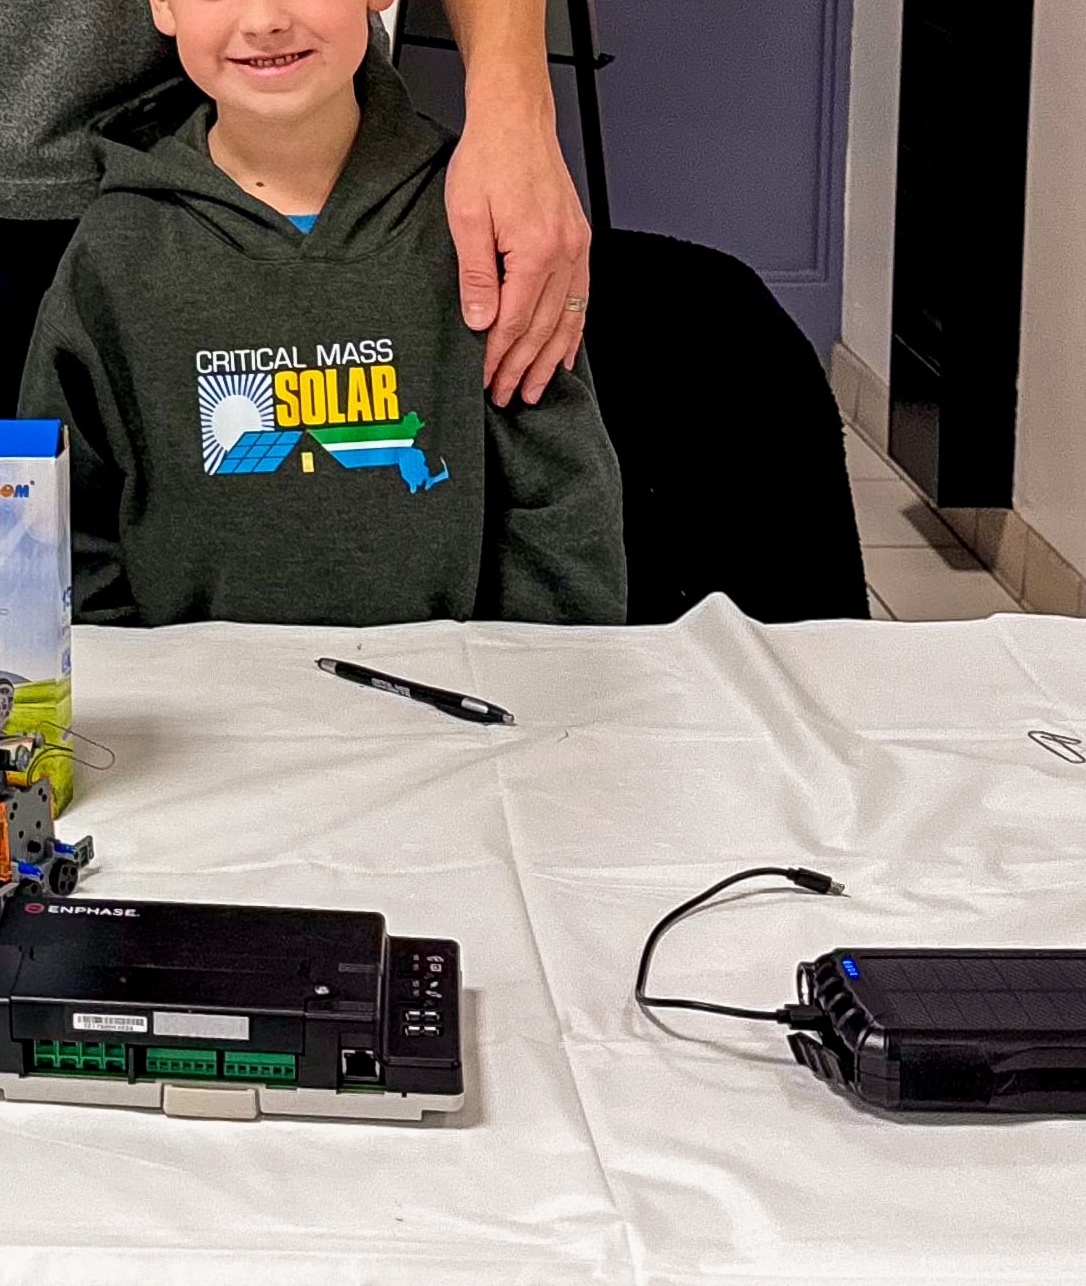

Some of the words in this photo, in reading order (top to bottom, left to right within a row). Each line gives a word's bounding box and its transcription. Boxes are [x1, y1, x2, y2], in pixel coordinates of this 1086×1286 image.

[195, 346, 307, 373] CRITICAL
[316, 339, 394, 367] MASS
[274, 365, 400, 427] SOLAR
[47, 905, 137, 917] ENPHASE
